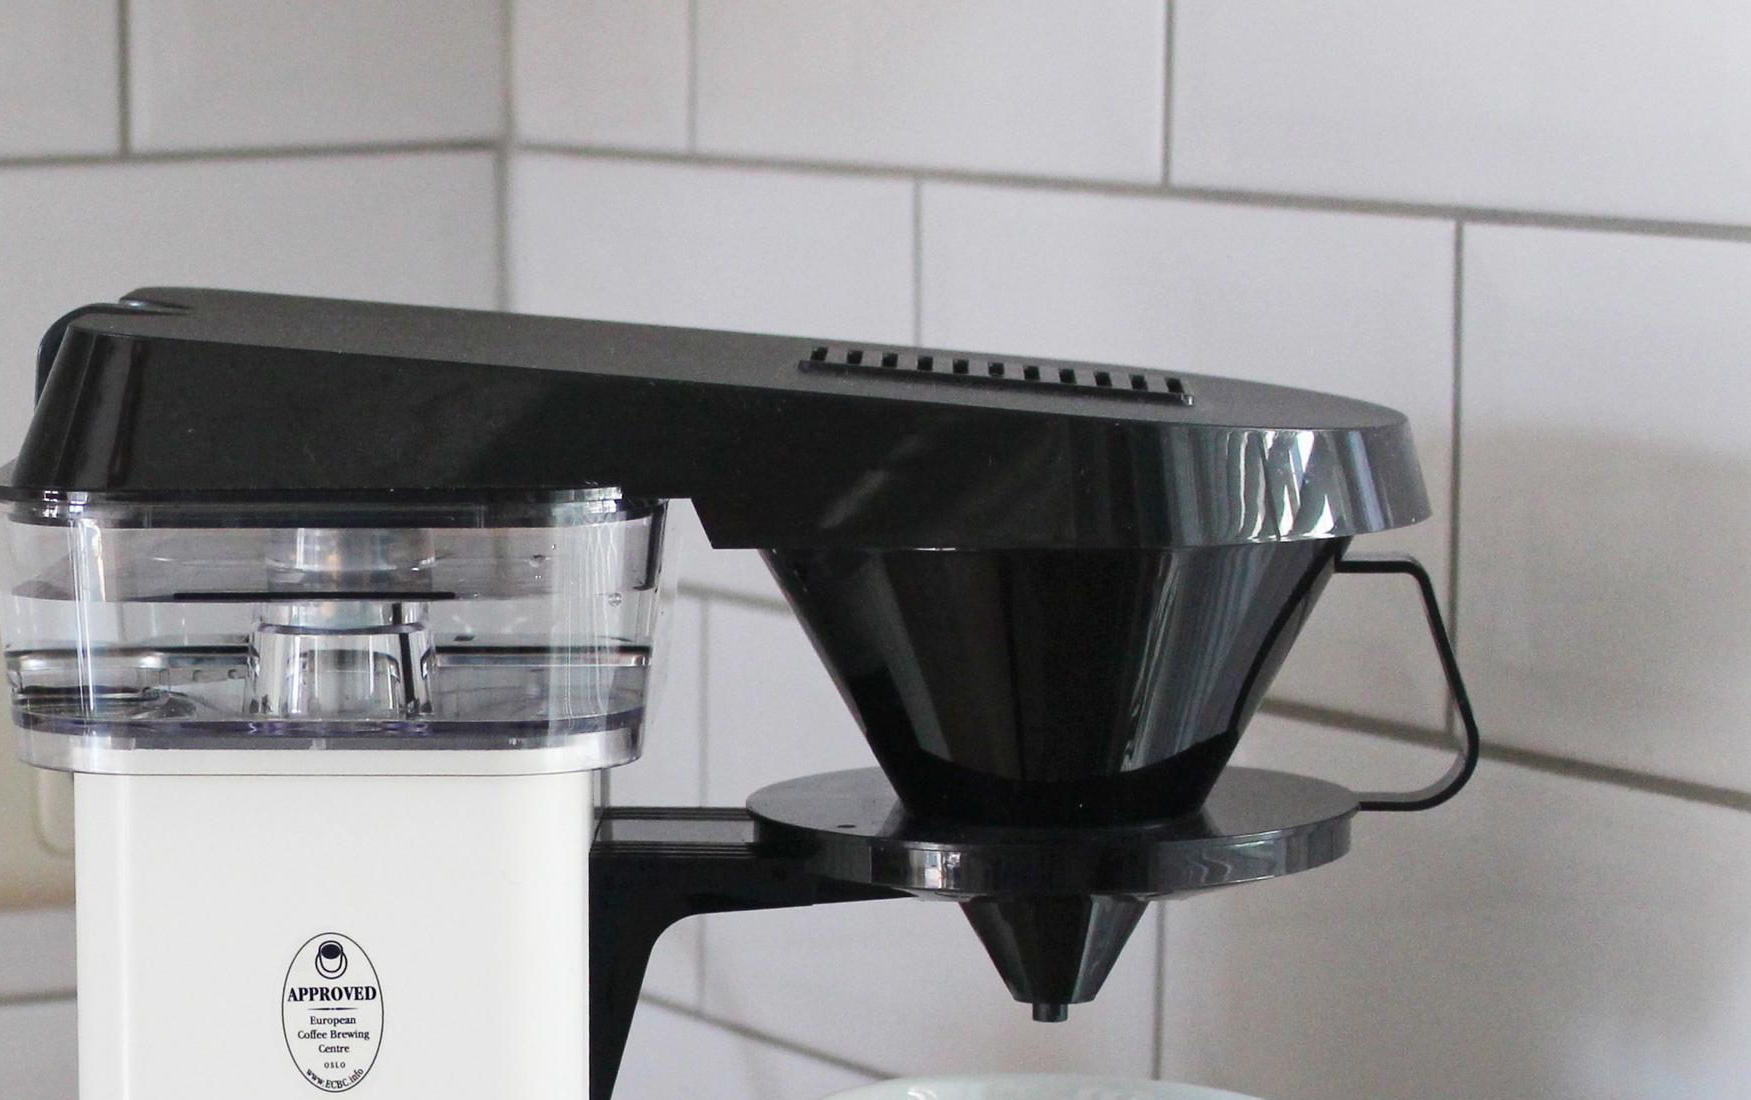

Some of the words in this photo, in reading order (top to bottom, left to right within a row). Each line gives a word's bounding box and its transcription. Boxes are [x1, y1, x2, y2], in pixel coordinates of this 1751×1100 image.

[287, 986, 377, 1002] APPROVED
[310, 1015, 356, 1026] European
[297, 1029, 327, 1040] Coffee
[330, 1029, 370, 1041] Brewing
[318, 1043, 350, 1054] Centre
[306, 1068, 364, 1088] www.ECBC.info
